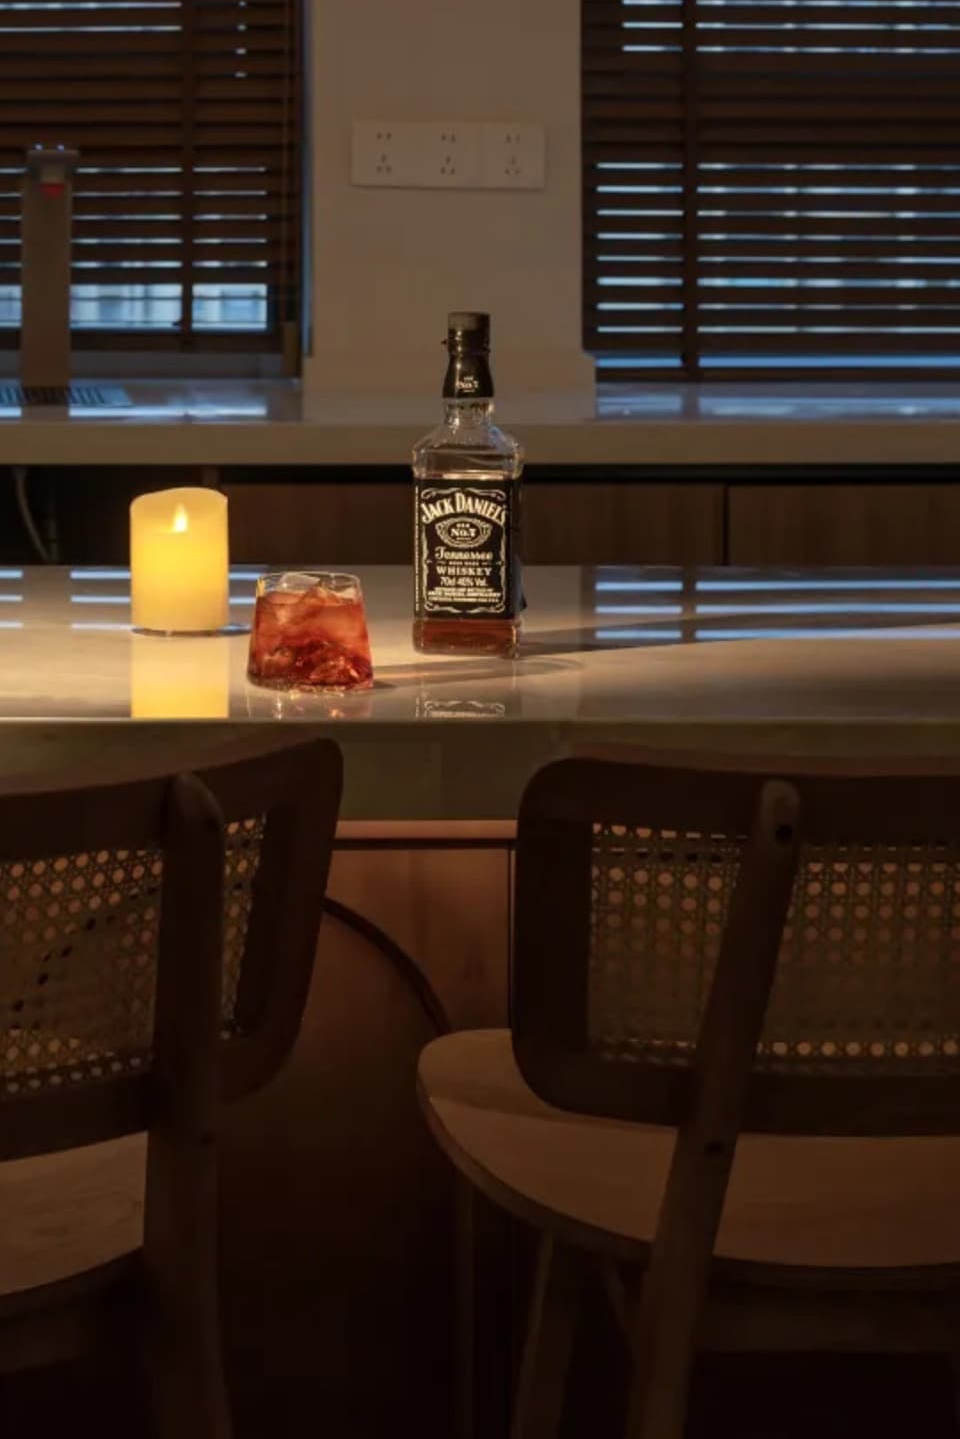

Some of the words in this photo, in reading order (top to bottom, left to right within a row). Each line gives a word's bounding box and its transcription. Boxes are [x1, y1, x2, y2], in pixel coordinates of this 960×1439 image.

[420, 498, 455, 524] JACK
[454, 492, 506, 525] DANIEL'S
[434, 546, 493, 559] Tennessee
[436, 566, 492, 576] WHISKEY
